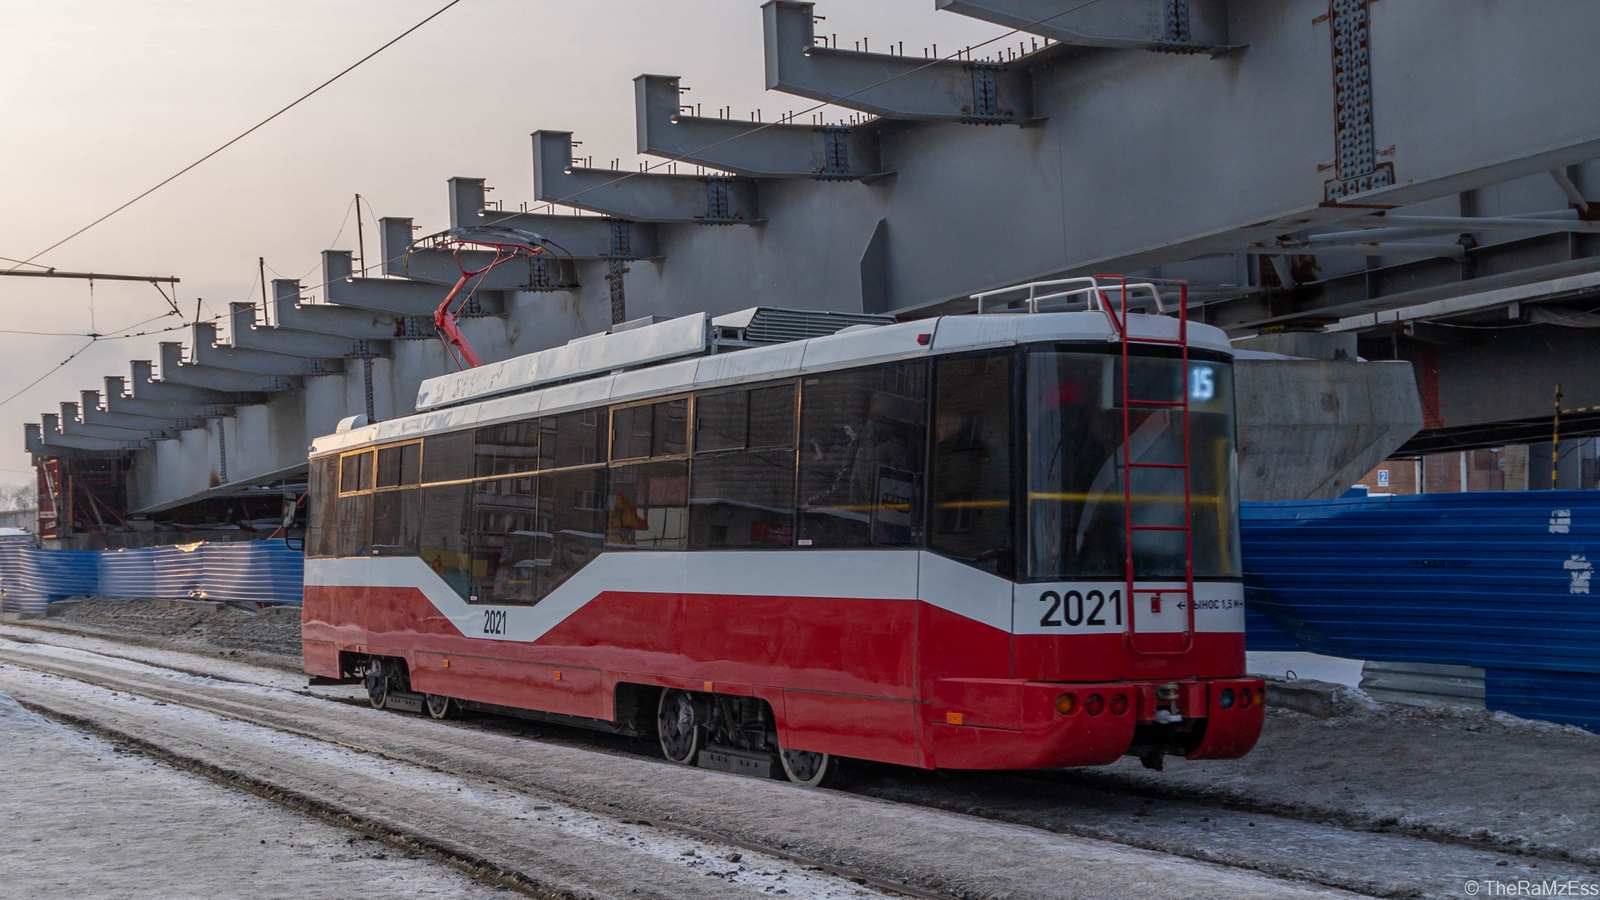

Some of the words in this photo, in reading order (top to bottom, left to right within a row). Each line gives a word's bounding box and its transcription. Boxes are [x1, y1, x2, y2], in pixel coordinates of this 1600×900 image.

[1192, 367, 1214, 399] 15
[1039, 590, 1122, 626] 2021
[1193, 600, 1220, 610] ЫНОС
[1222, 600, 1232, 611] 1,5
[484, 610, 507, 635] 2021
